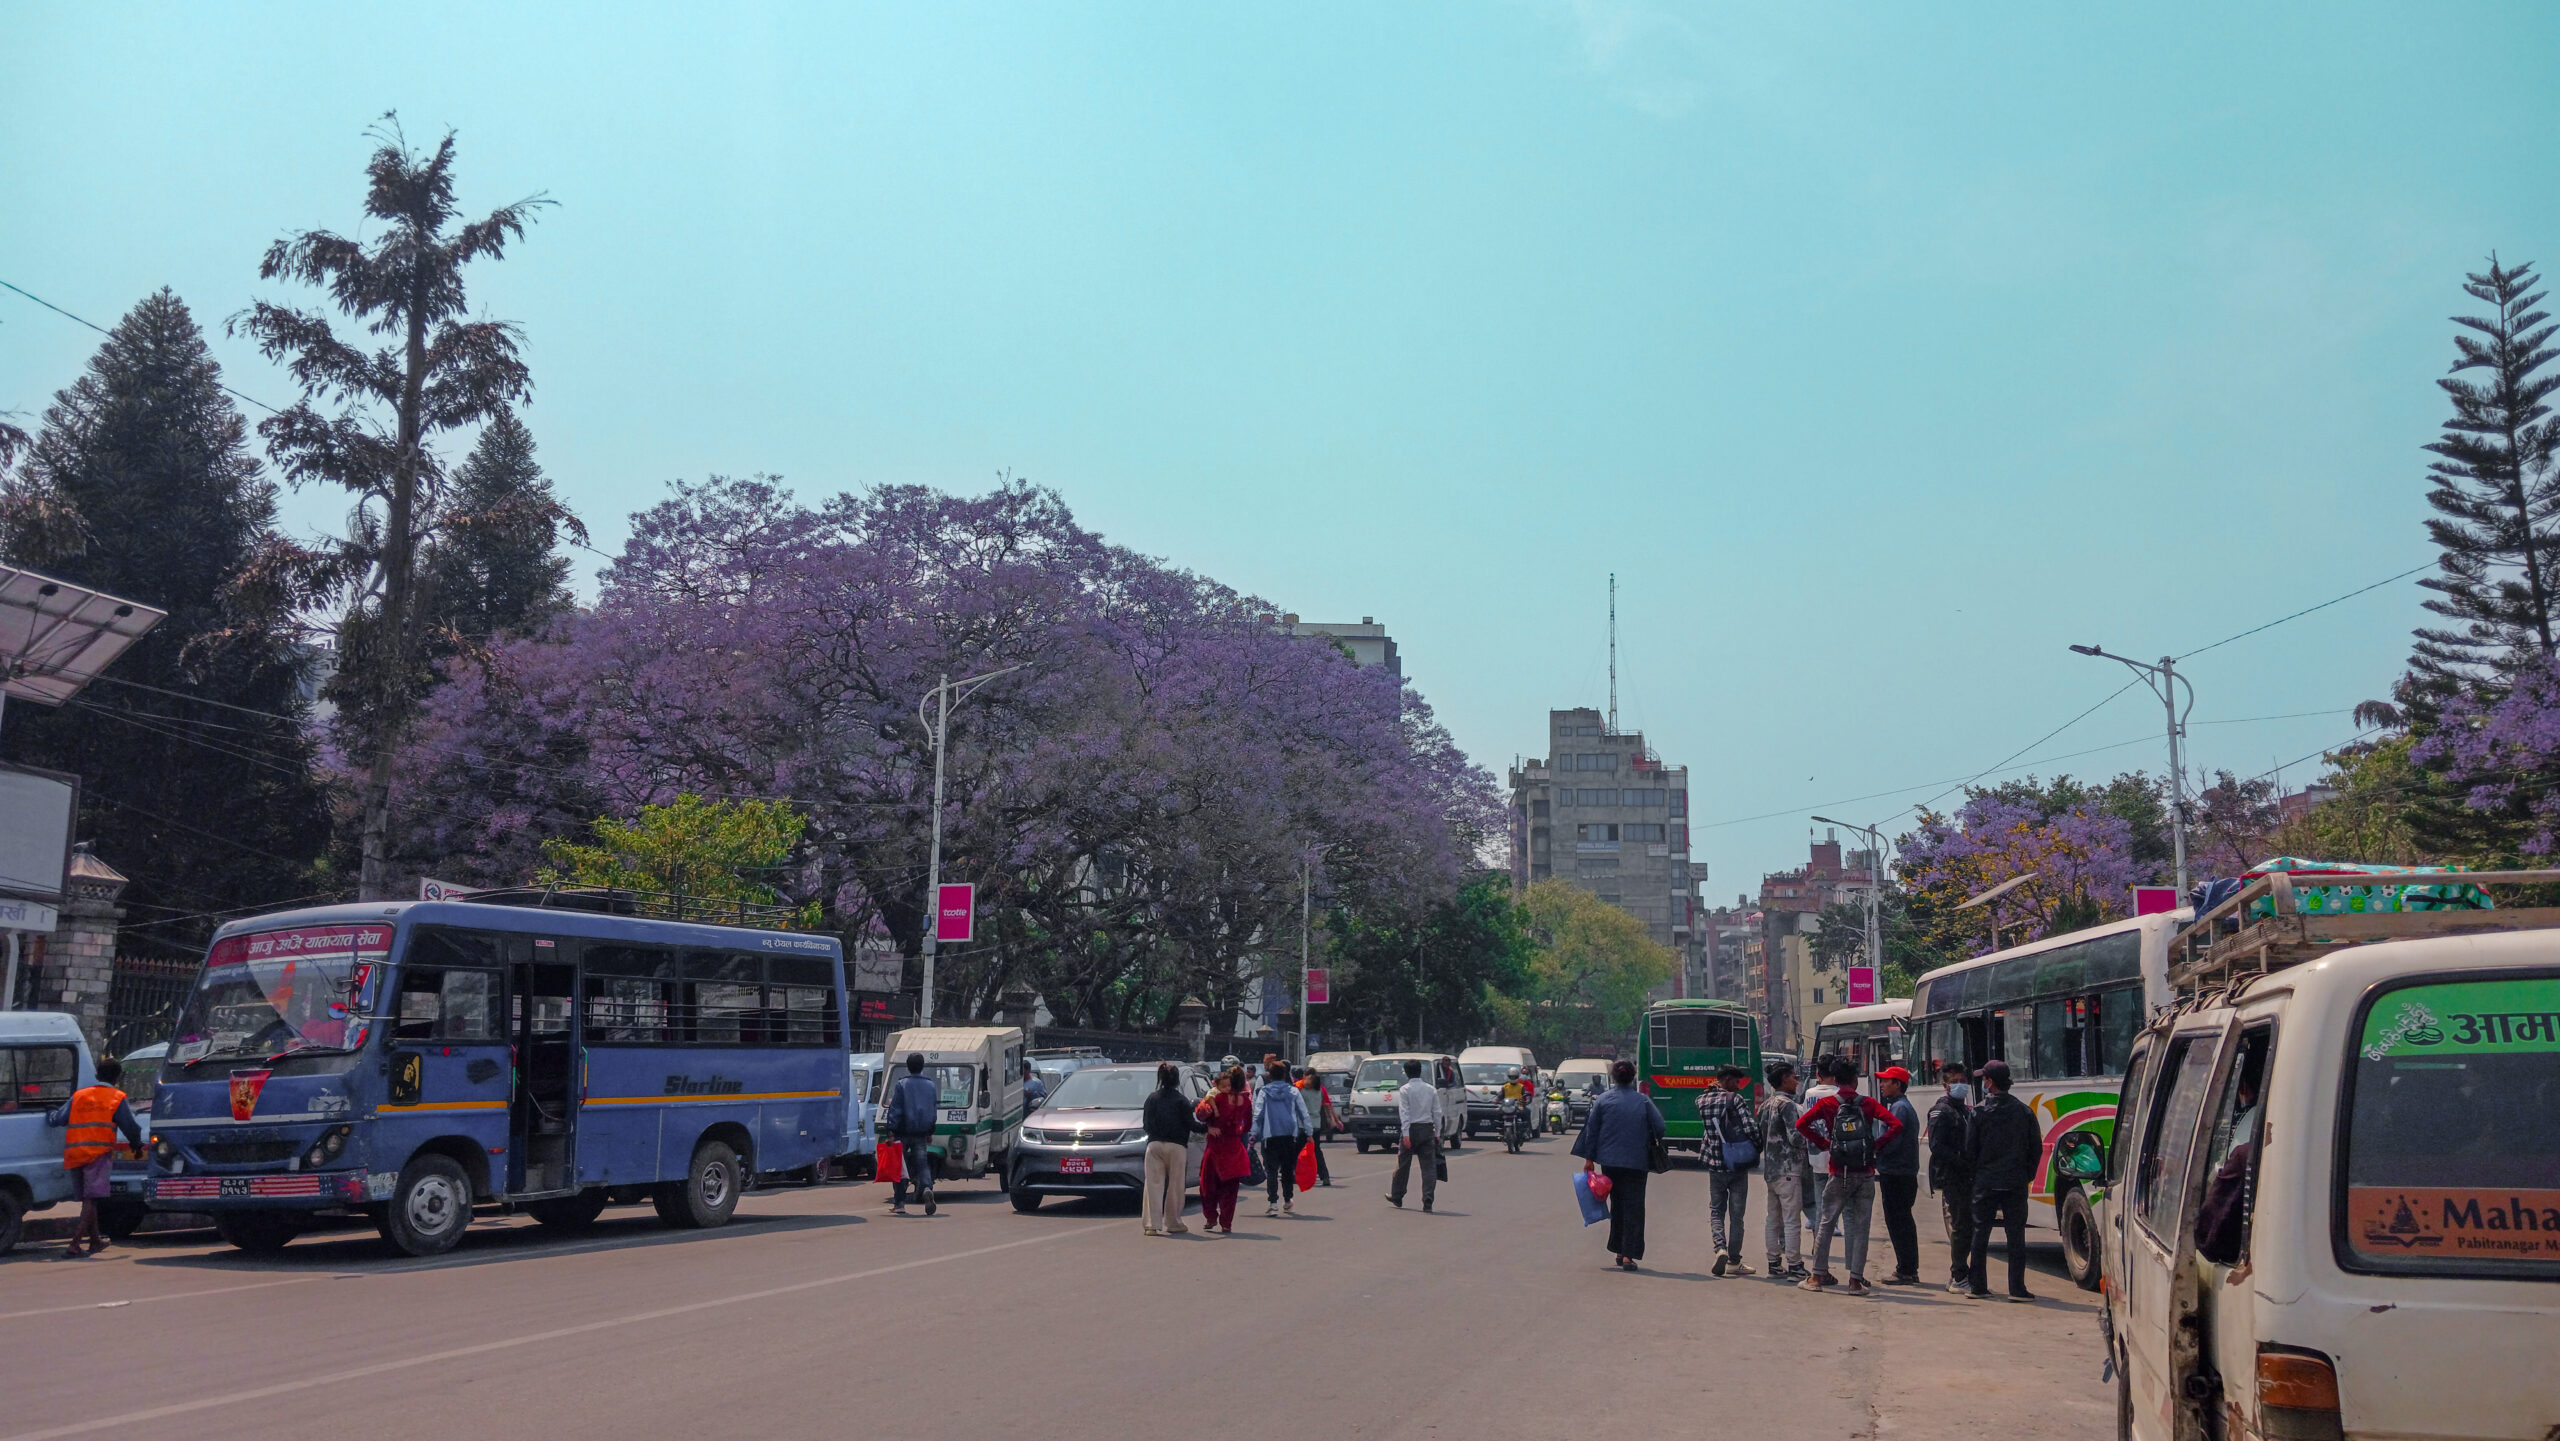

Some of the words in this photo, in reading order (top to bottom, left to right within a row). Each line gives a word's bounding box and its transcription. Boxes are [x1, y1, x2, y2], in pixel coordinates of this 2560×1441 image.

[248, 940, 275, 955] आजु
[305, 933, 353, 948] यातायात
[356, 929, 383, 946] सेवा
[2447, 1012, 2560, 1045] आम
[929, 1052, 939, 1060] 20
[1664, 1077, 1705, 1085] KANTIPUR
[1841, 1121, 1857, 1132] CAT
[2457, 1236, 2541, 1253] Pabitranagar
